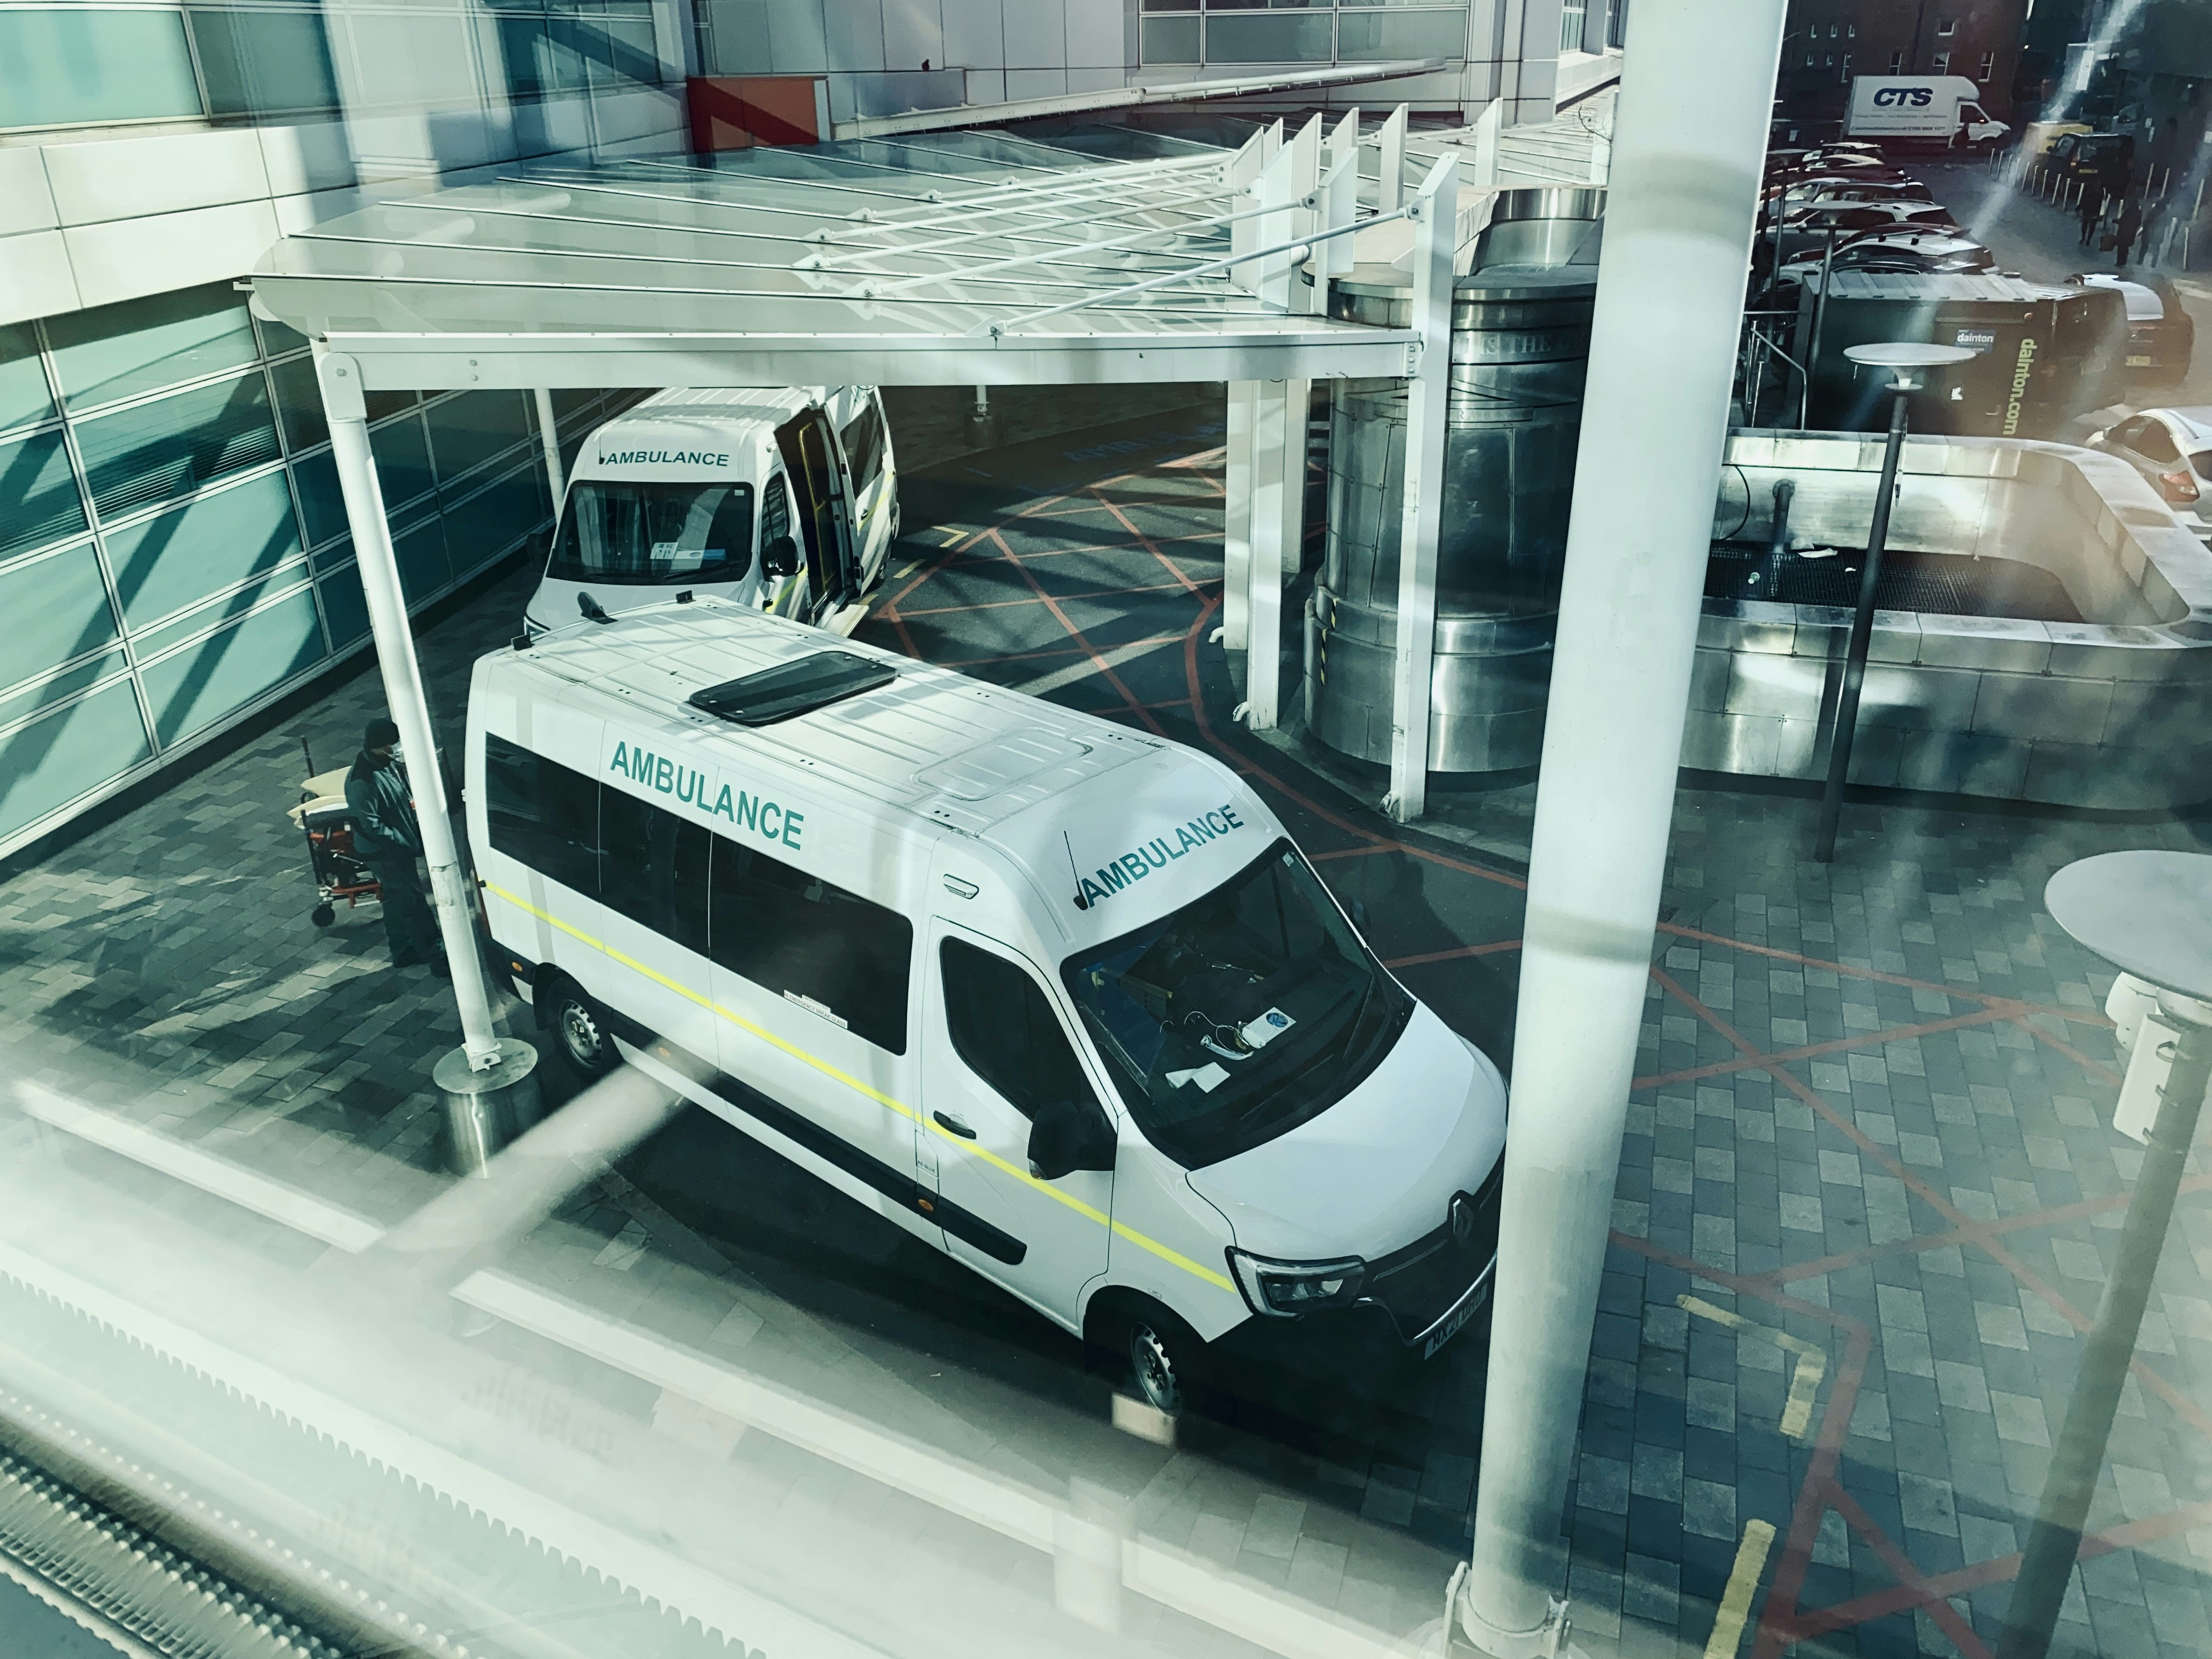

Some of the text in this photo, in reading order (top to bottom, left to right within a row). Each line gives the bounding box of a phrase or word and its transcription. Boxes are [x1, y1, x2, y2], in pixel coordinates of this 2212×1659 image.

[1874, 88, 1933, 106] CTS
[1507, 335, 1550, 354] THE
[1957, 333, 1993, 342] dainton
[2003, 338, 2037, 435] dainton.com
[606, 451, 729, 466] AMBULANCE
[610, 741, 804, 850] AMBULANCE
[1081, 804, 1244, 908] AMBULANCE
[789, 995, 815, 1011] EMERGENCY
[816, 1008, 831, 1019] BREAK
[831, 1017, 846, 1027] GLASS
